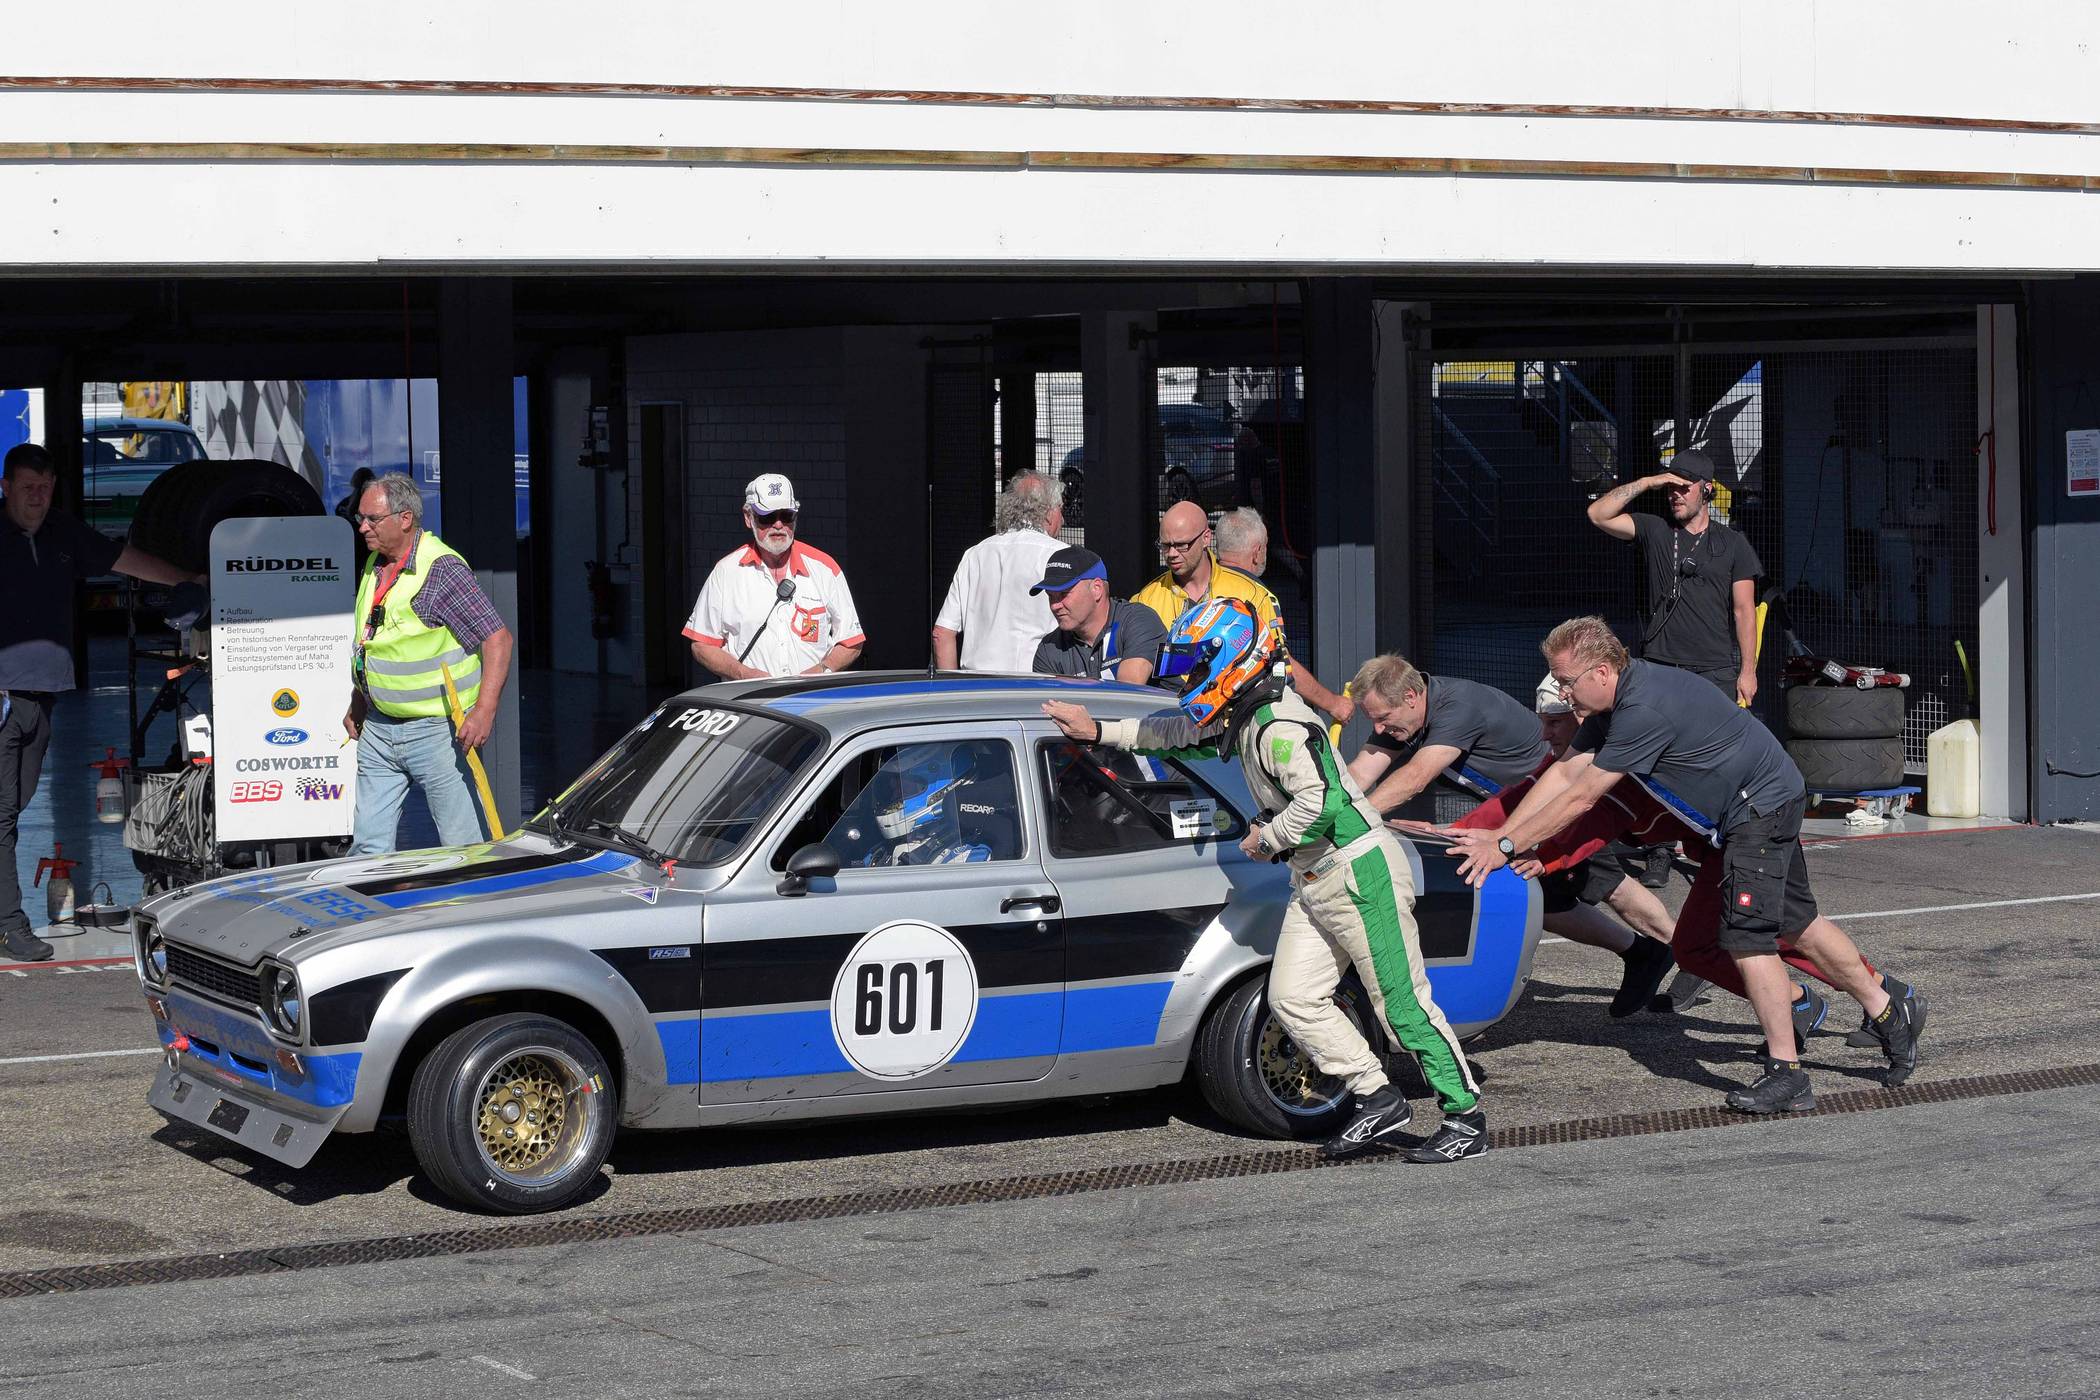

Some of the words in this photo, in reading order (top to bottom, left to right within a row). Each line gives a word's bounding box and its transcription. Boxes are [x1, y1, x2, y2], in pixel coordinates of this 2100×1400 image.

[226, 556, 339, 572] RÜDDEL
[226, 616, 273, 625] Restauration
[227, 627, 265, 635] Betreuung
[242, 635, 286, 643] historischen
[288, 634, 348, 642] Rennfahrzeugen
[284, 644, 317, 652] Vergaser
[227, 655, 294, 663] Einspritzsystemen
[227, 662, 297, 672] Leistungsprüfstand
[298, 662, 314, 670] LPS
[668, 708, 740, 736] FORD
[272, 730, 300, 743] Ford
[236, 756, 339, 772] COSWORTH
[230, 780, 283, 803] BBS
[304, 784, 344, 800] KW
[855, 959, 944, 1036] 601
